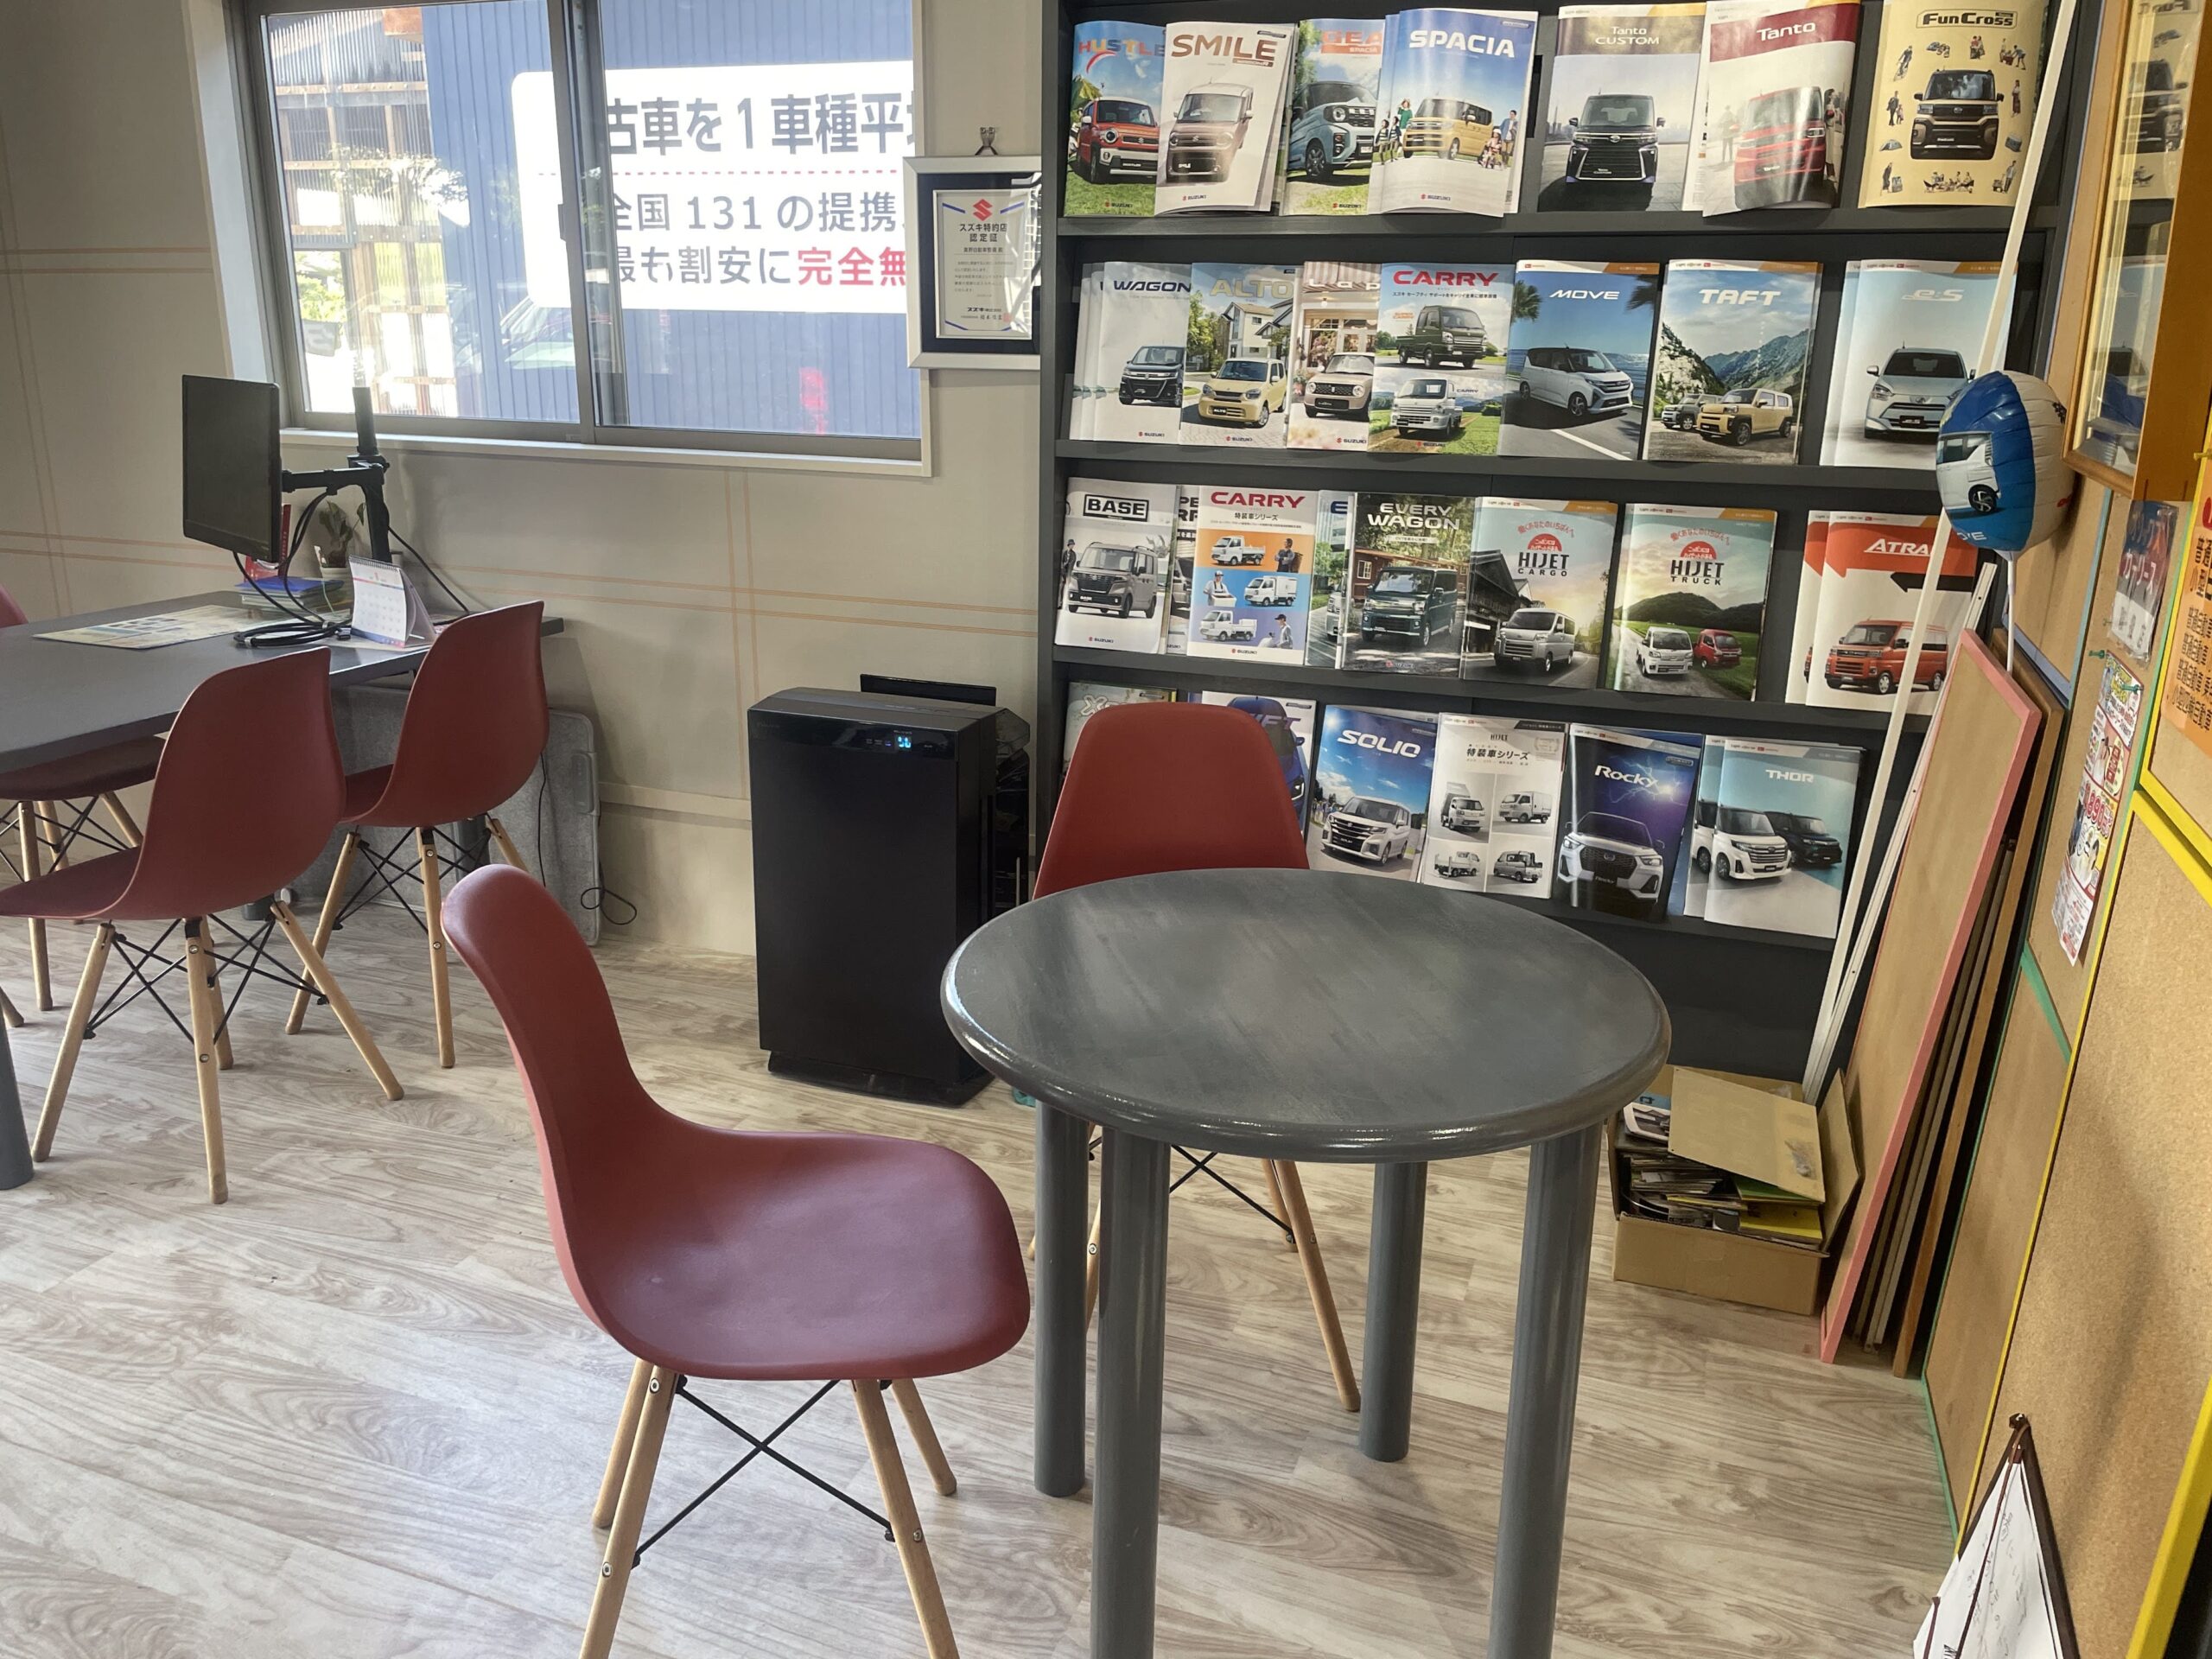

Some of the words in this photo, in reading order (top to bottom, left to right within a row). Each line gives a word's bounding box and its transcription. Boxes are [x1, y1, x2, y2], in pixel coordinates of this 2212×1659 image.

[1923, 12, 2013, 26] FunCross
[1611, 26, 1647, 35] Tanto
[1757, 22, 1815, 41] Tanto
[1171, 34, 1278, 61] SMILE
[1409, 29, 1516, 58] SPACIA
[1595, 36, 1659, 45] CUSTOM
[1113, 280, 1192, 292] WAGON
[1393, 270, 1499, 287] CARRY
[1210, 278, 1294, 299] ALTO
[1549, 289, 1620, 300] MOVE
[1699, 289, 1782, 306] TAFT
[1087, 499, 1146, 516] BASE
[1211, 492, 1306, 509] CARRY
[1380, 502, 1452, 516] EVERY
[1367, 513, 1460, 530] WAGON
[1518, 551, 1569, 569] HIJET
[1517, 568, 1567, 577] CARGO
[1670, 560, 1725, 578] HIJET
[1670, 575, 1721, 586] TRUCK
[1337, 728, 1421, 759] SOLIO
[1466, 747, 1529, 760] 特装車シリーズ
[1765, 769, 1815, 783] THOR
